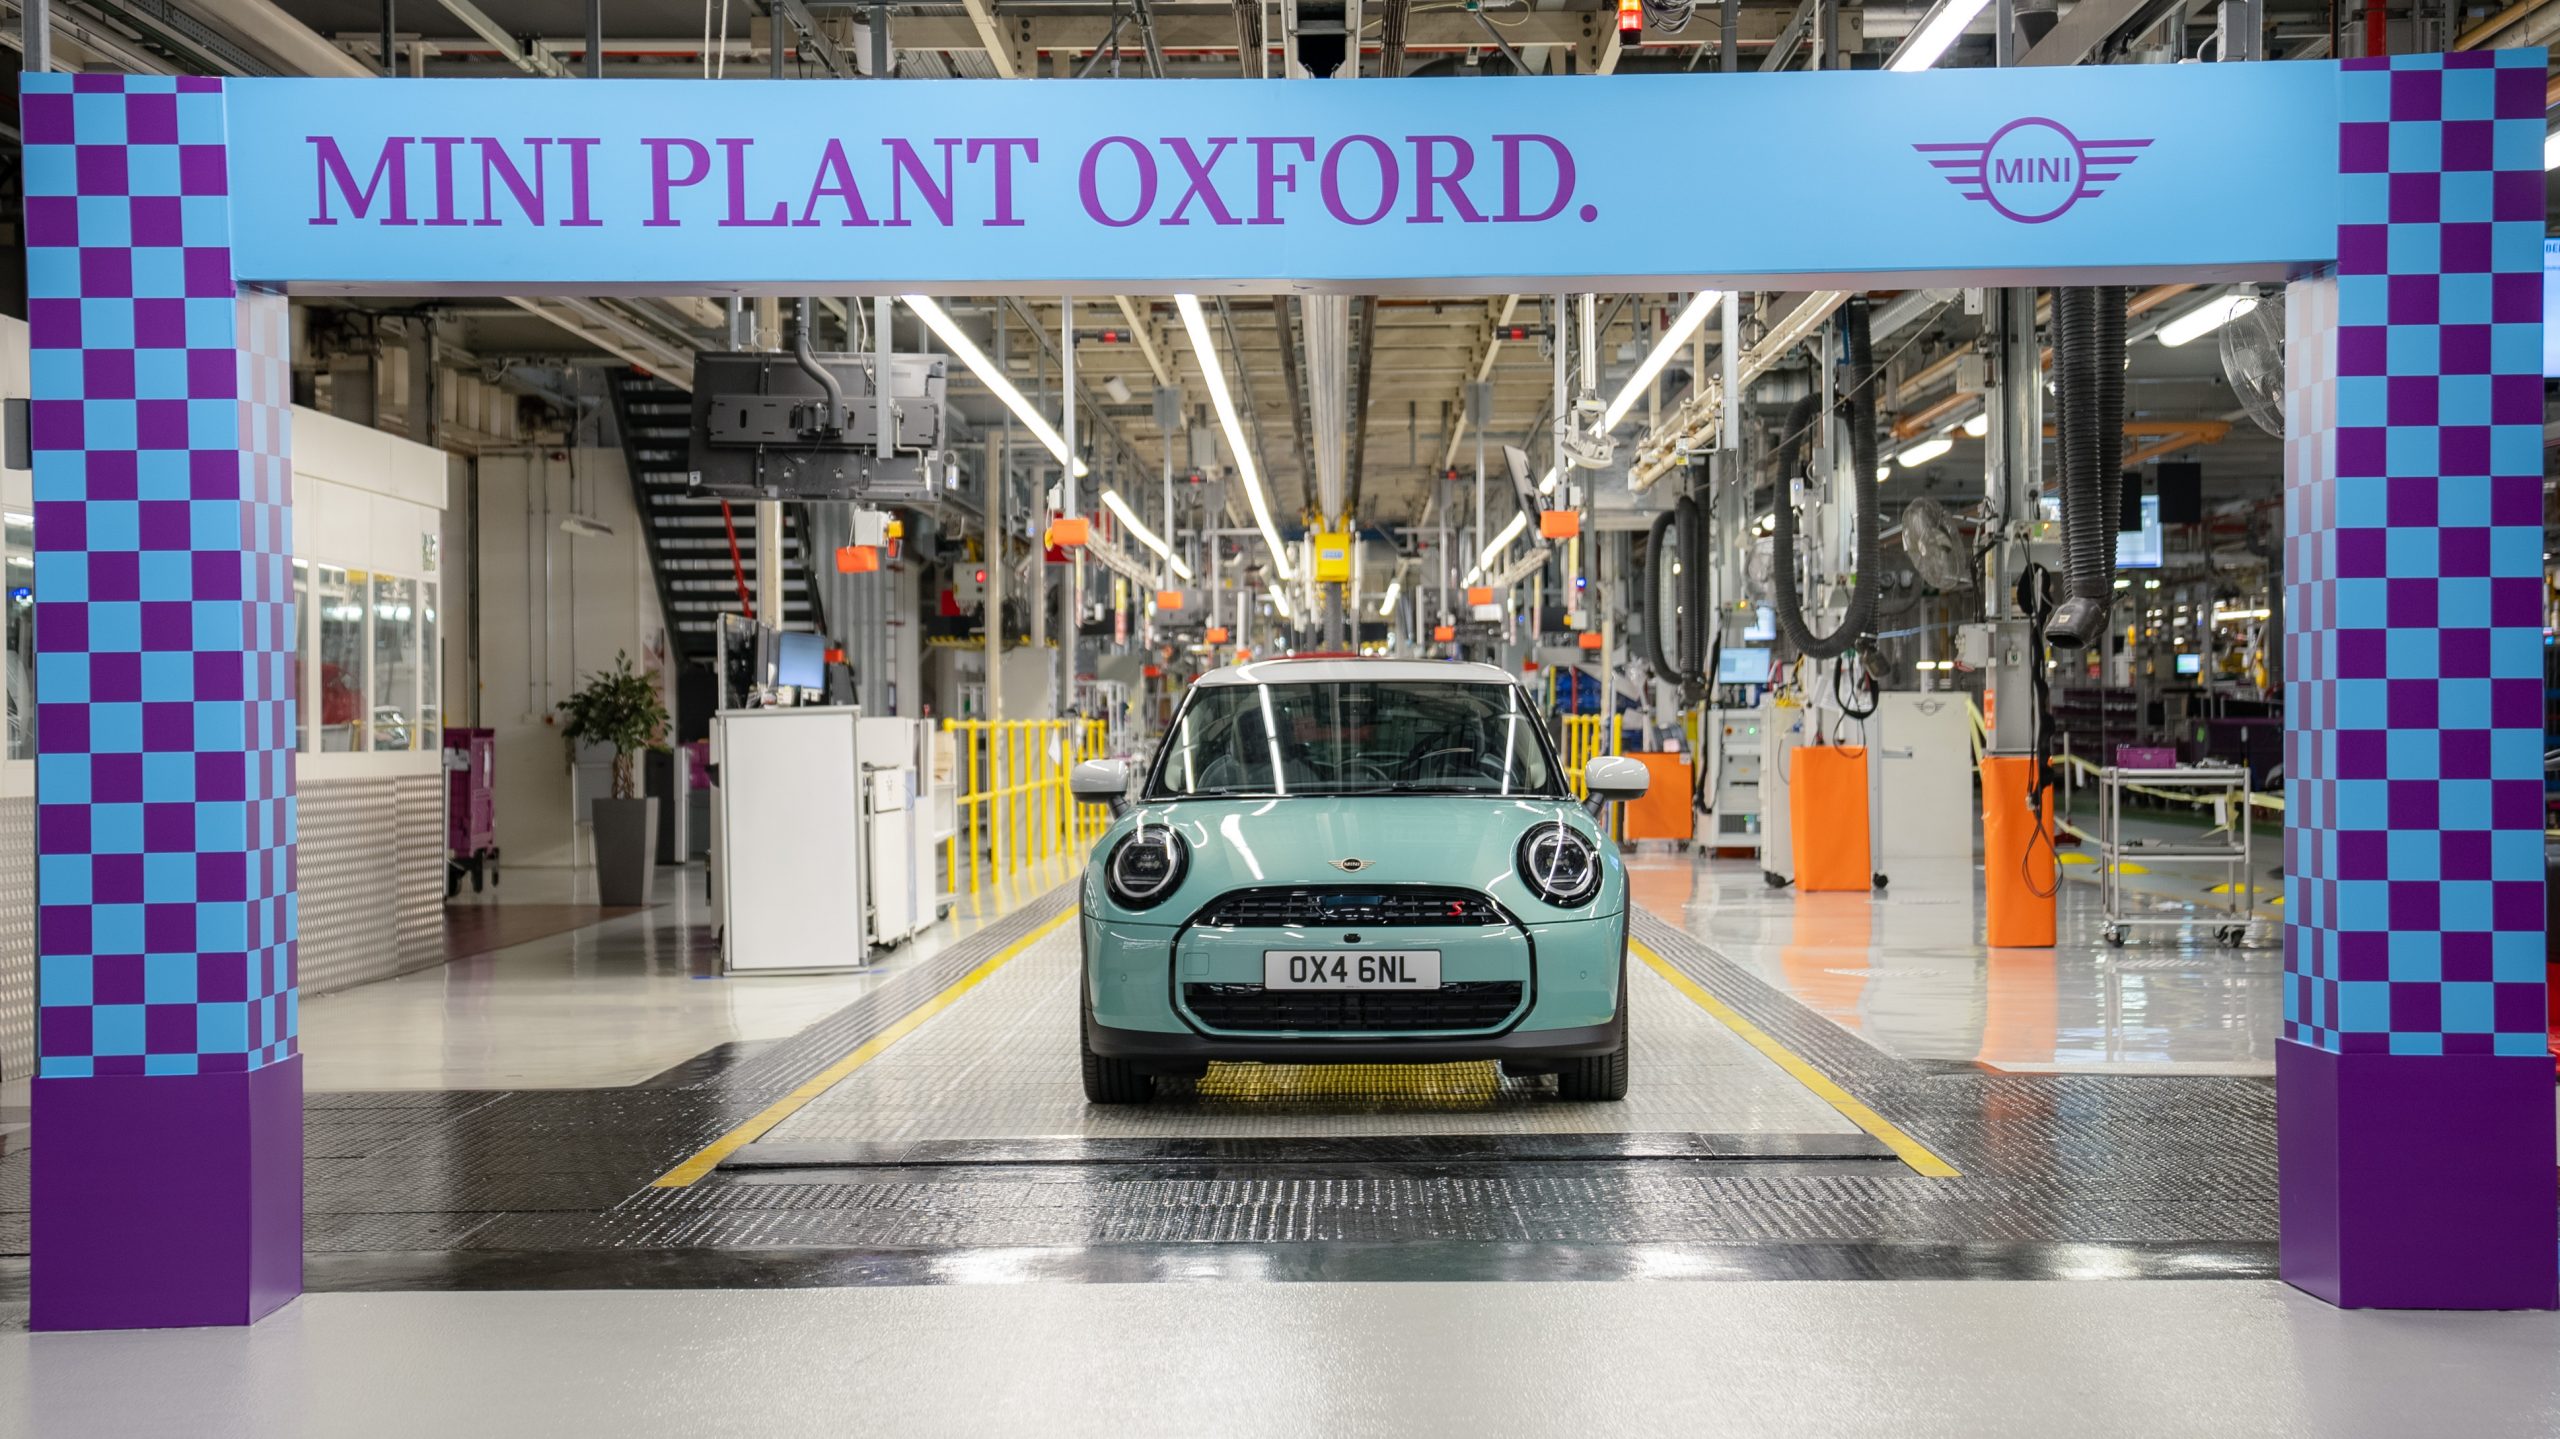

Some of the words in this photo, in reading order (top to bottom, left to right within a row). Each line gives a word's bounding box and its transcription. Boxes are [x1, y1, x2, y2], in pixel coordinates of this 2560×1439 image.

[305, 136, 603, 226] MINI
[640, 137, 1039, 227] PLANT
[1077, 134, 1599, 227] OXFORD.
[1995, 157, 2071, 184] MINI
[1289, 955, 1348, 983] OX4
[1358, 955, 1417, 983] 6NL
